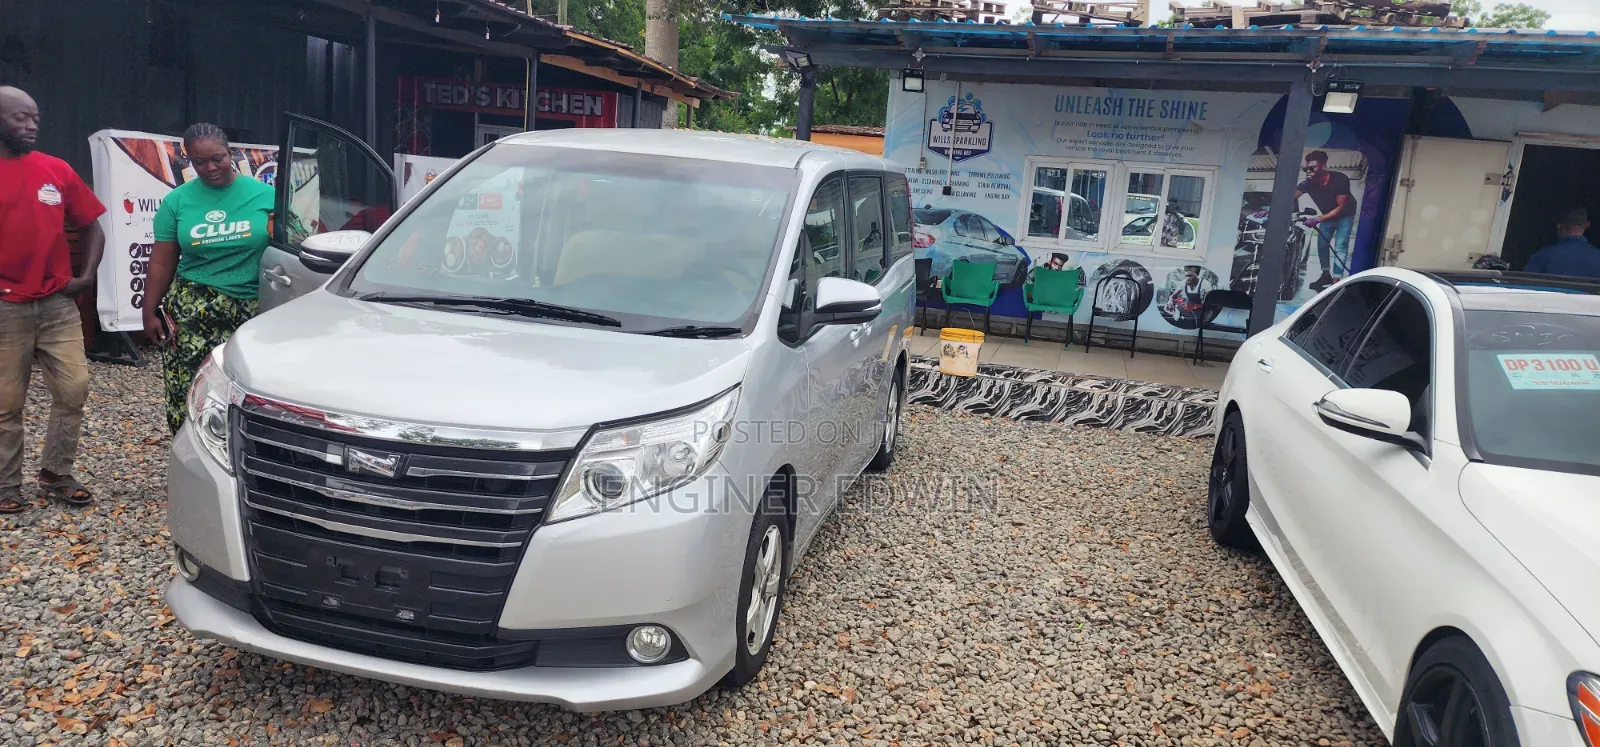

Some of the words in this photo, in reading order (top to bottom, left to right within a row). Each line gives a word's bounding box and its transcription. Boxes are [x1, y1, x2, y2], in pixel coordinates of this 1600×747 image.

[422, 83, 492, 108] TED'S
[1054, 94, 1124, 117] UNLEASH
[1128, 97, 1156, 118] THE
[1159, 99, 1209, 121] SHINE
[932, 135, 951, 144] WILLS
[953, 135, 987, 146] SPARKLING
[1087, 130, 1109, 139] Look
[1111, 132, 1123, 140] no
[1126, 132, 1165, 142] further!
[1128, 141, 1157, 149] designed
[1115, 147, 1147, 155] treatment
[1153, 150, 1184, 158] deserves.
[190, 220, 251, 239] CLUB
[201, 237, 225, 245] PREMIUM
[1503, 358, 1529, 371] DP
[1531, 358, 1583, 371] 3100
[1583, 358, 1599, 371] U
